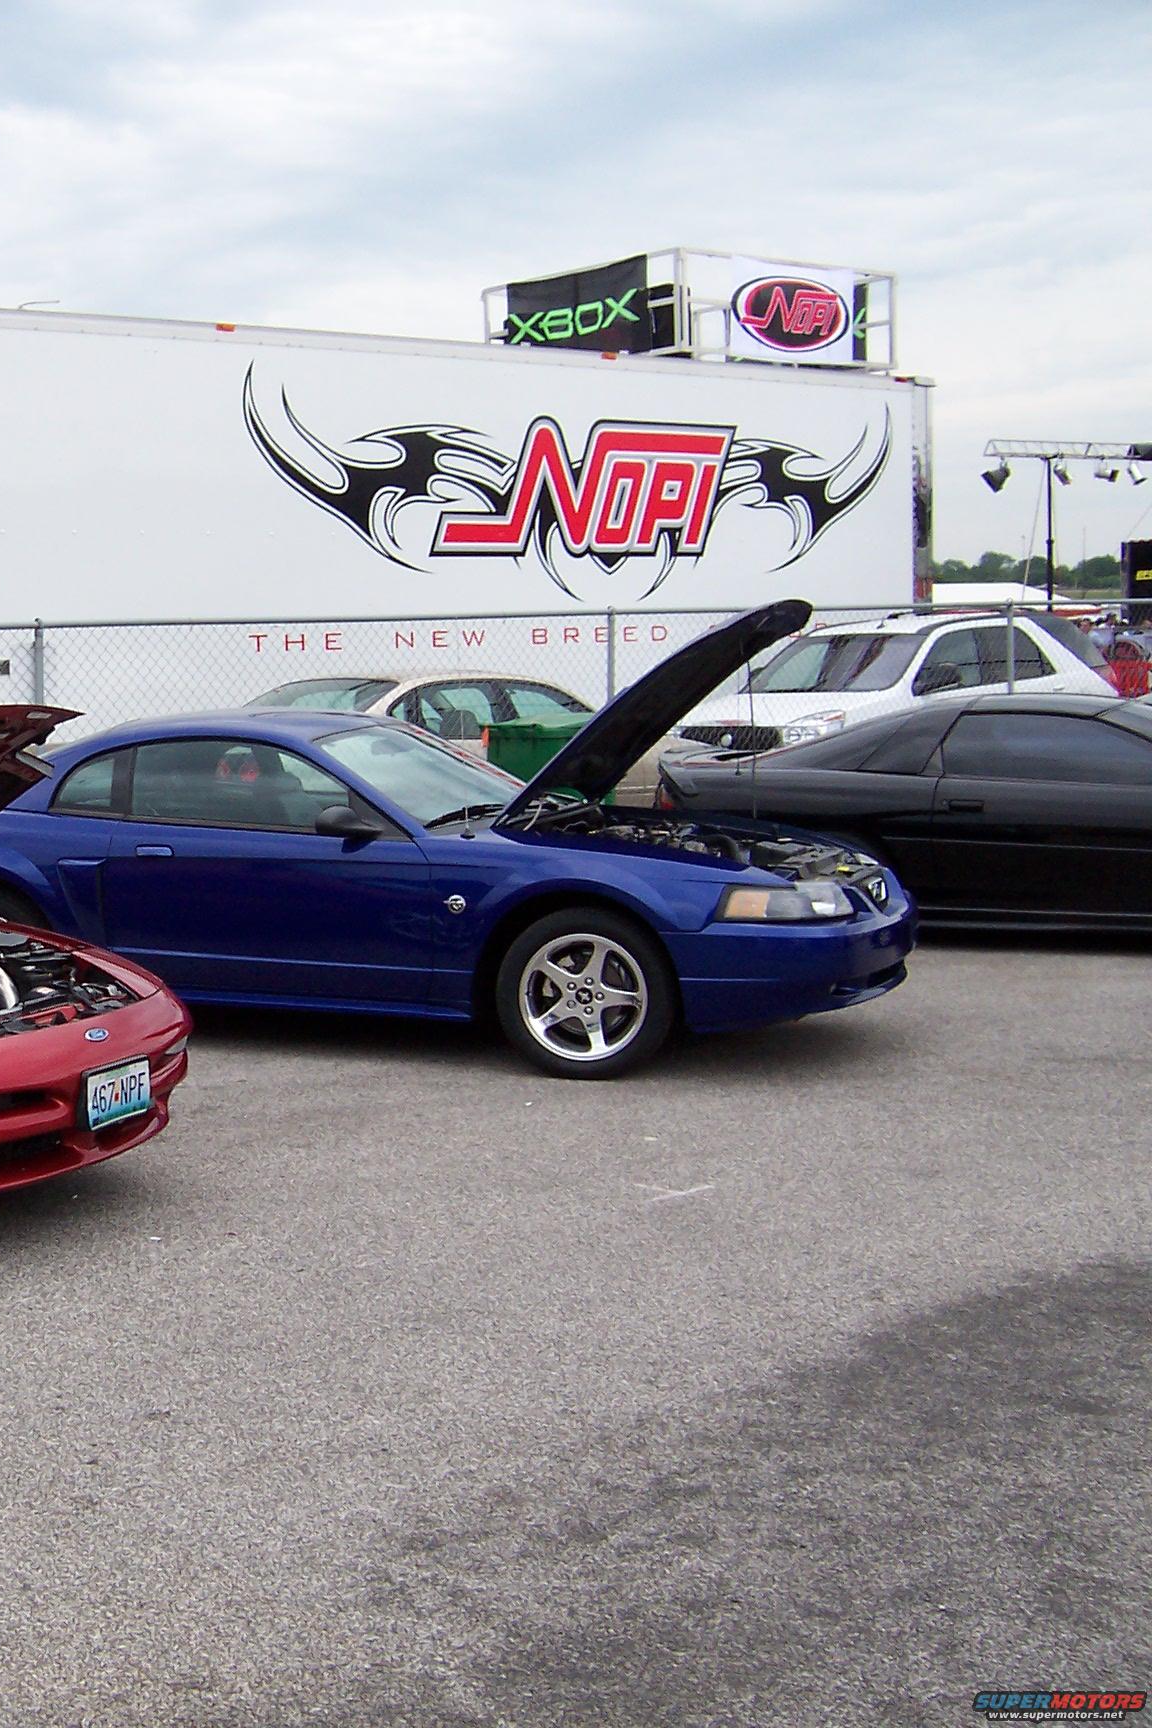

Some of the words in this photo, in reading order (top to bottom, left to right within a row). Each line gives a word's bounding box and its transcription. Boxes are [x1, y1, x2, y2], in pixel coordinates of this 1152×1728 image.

[508, 288, 640, 344] XBOX
[740, 286, 838, 336] NOPI
[430, 415, 737, 557] NOPI
[249, 632, 342, 652] THE
[394, 630, 485, 649] NEW
[532, 625, 668, 645] BREED
